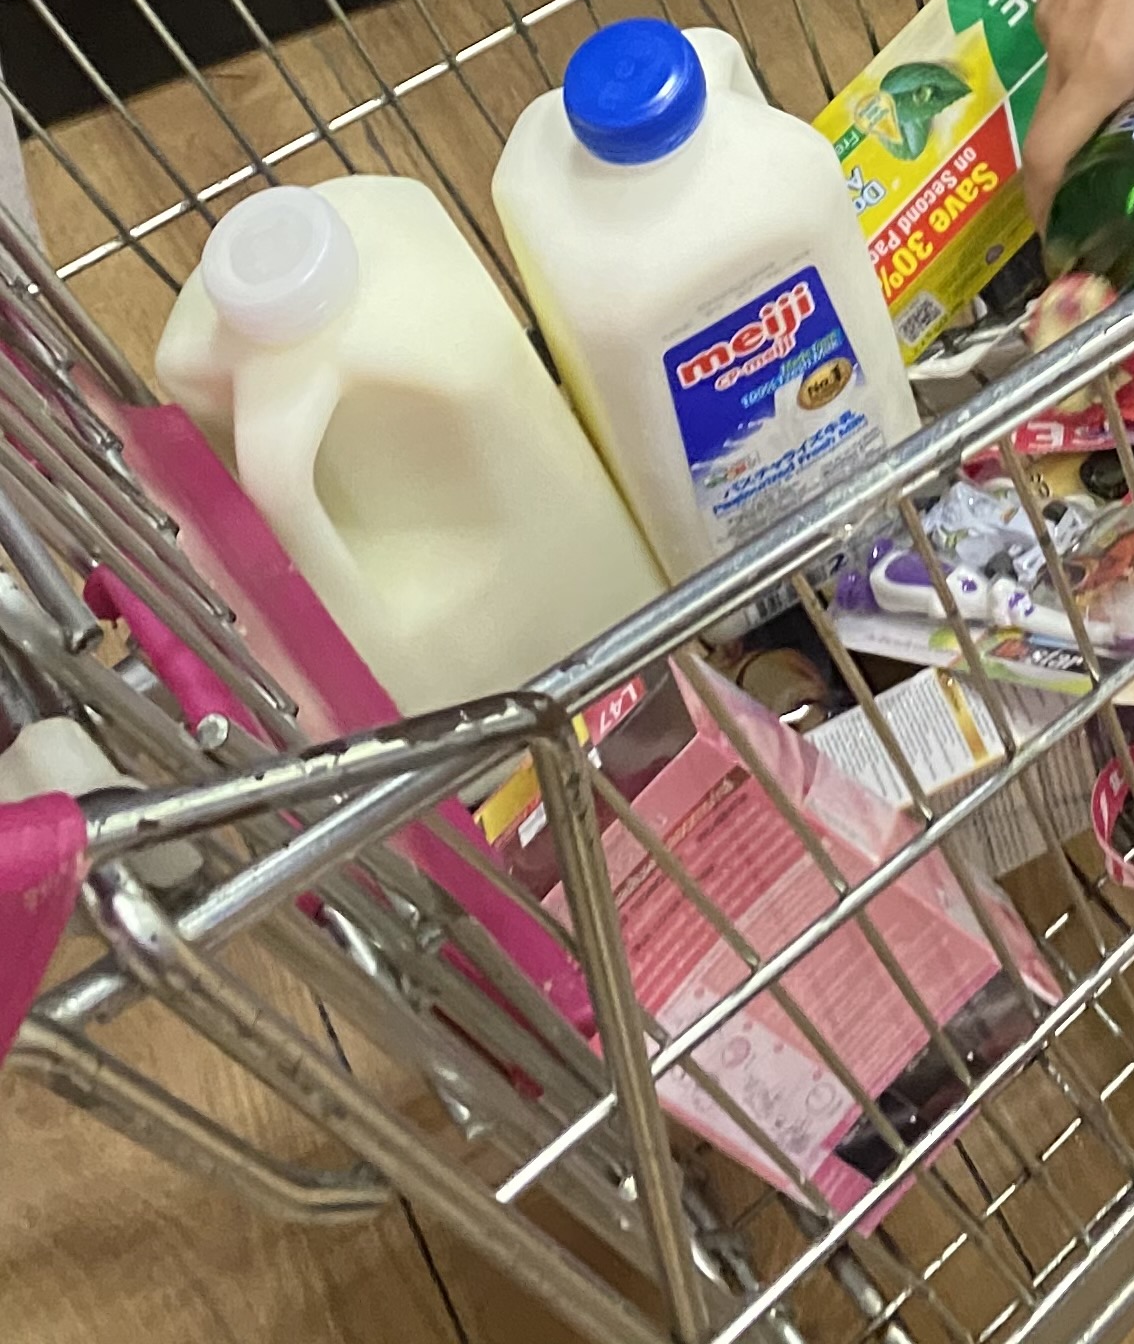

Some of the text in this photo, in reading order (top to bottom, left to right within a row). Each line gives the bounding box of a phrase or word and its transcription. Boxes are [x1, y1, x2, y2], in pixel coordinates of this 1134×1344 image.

[954, 147, 977, 173] on
[897, 170, 957, 235] Second
[928, 162, 999, 234] Save
[679, 282, 814, 388] meiji
